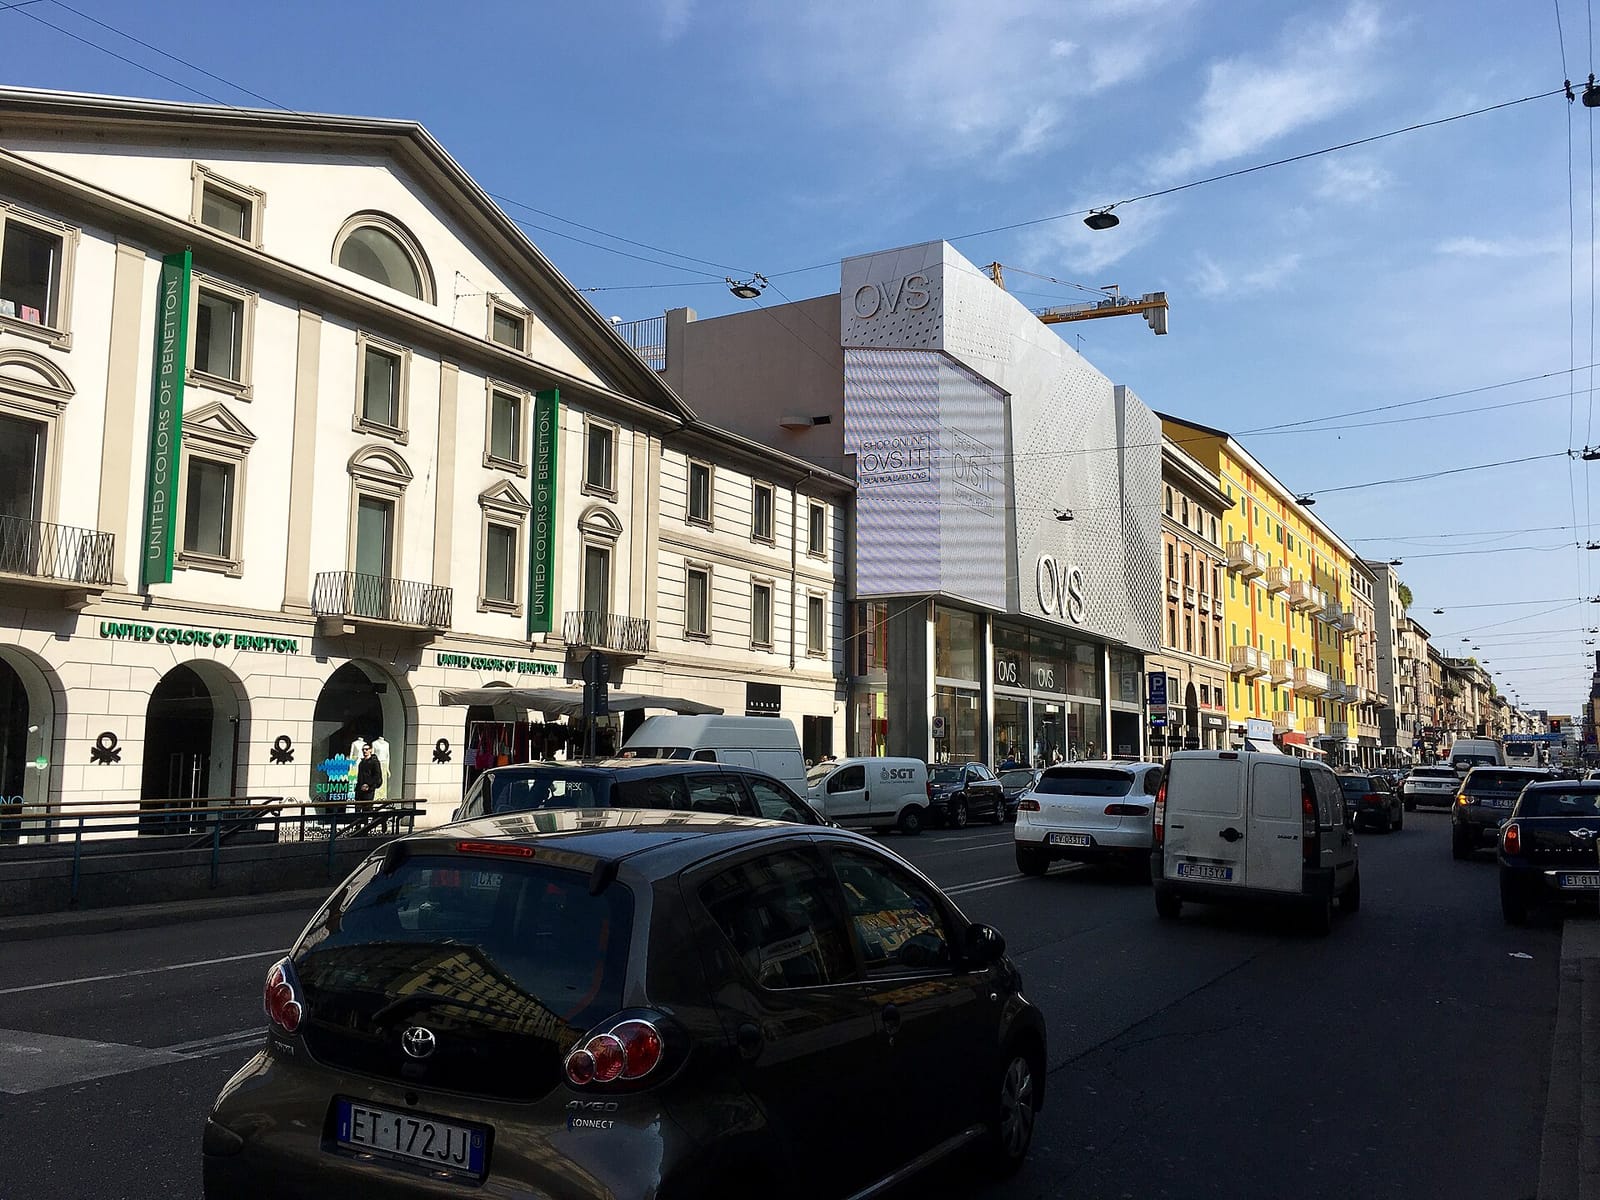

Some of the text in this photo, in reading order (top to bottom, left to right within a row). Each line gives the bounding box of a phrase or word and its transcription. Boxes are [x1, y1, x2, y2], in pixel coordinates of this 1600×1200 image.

[855, 274, 930, 319] OVS
[149, 275, 178, 560] UNITED COLORS OF BENETTON.
[863, 435, 926, 451] SHOP ONLINE
[863, 448, 926, 471] OVS.IT
[912, 471, 927, 480] OVS
[954, 453, 992, 492] OVS.IT
[534, 407, 550, 615] UNITED COLORS OF BENETTON.
[1035, 553, 1084, 624] OVS
[100, 621, 155, 641] UNITED
[155, 627, 212, 647] COLORS
[213, 631, 233, 648] OF
[437, 653, 471, 668] UNITED
[471, 656, 505, 672] COLORS
[505, 659, 518, 673] OF
[998, 660, 1017, 682] OVS
[1038, 668, 1054, 689] OVS
[889, 768, 916, 780] SGT
[316, 783, 357, 794] SUMME
[394, 1117, 467, 1164] 172JJ
